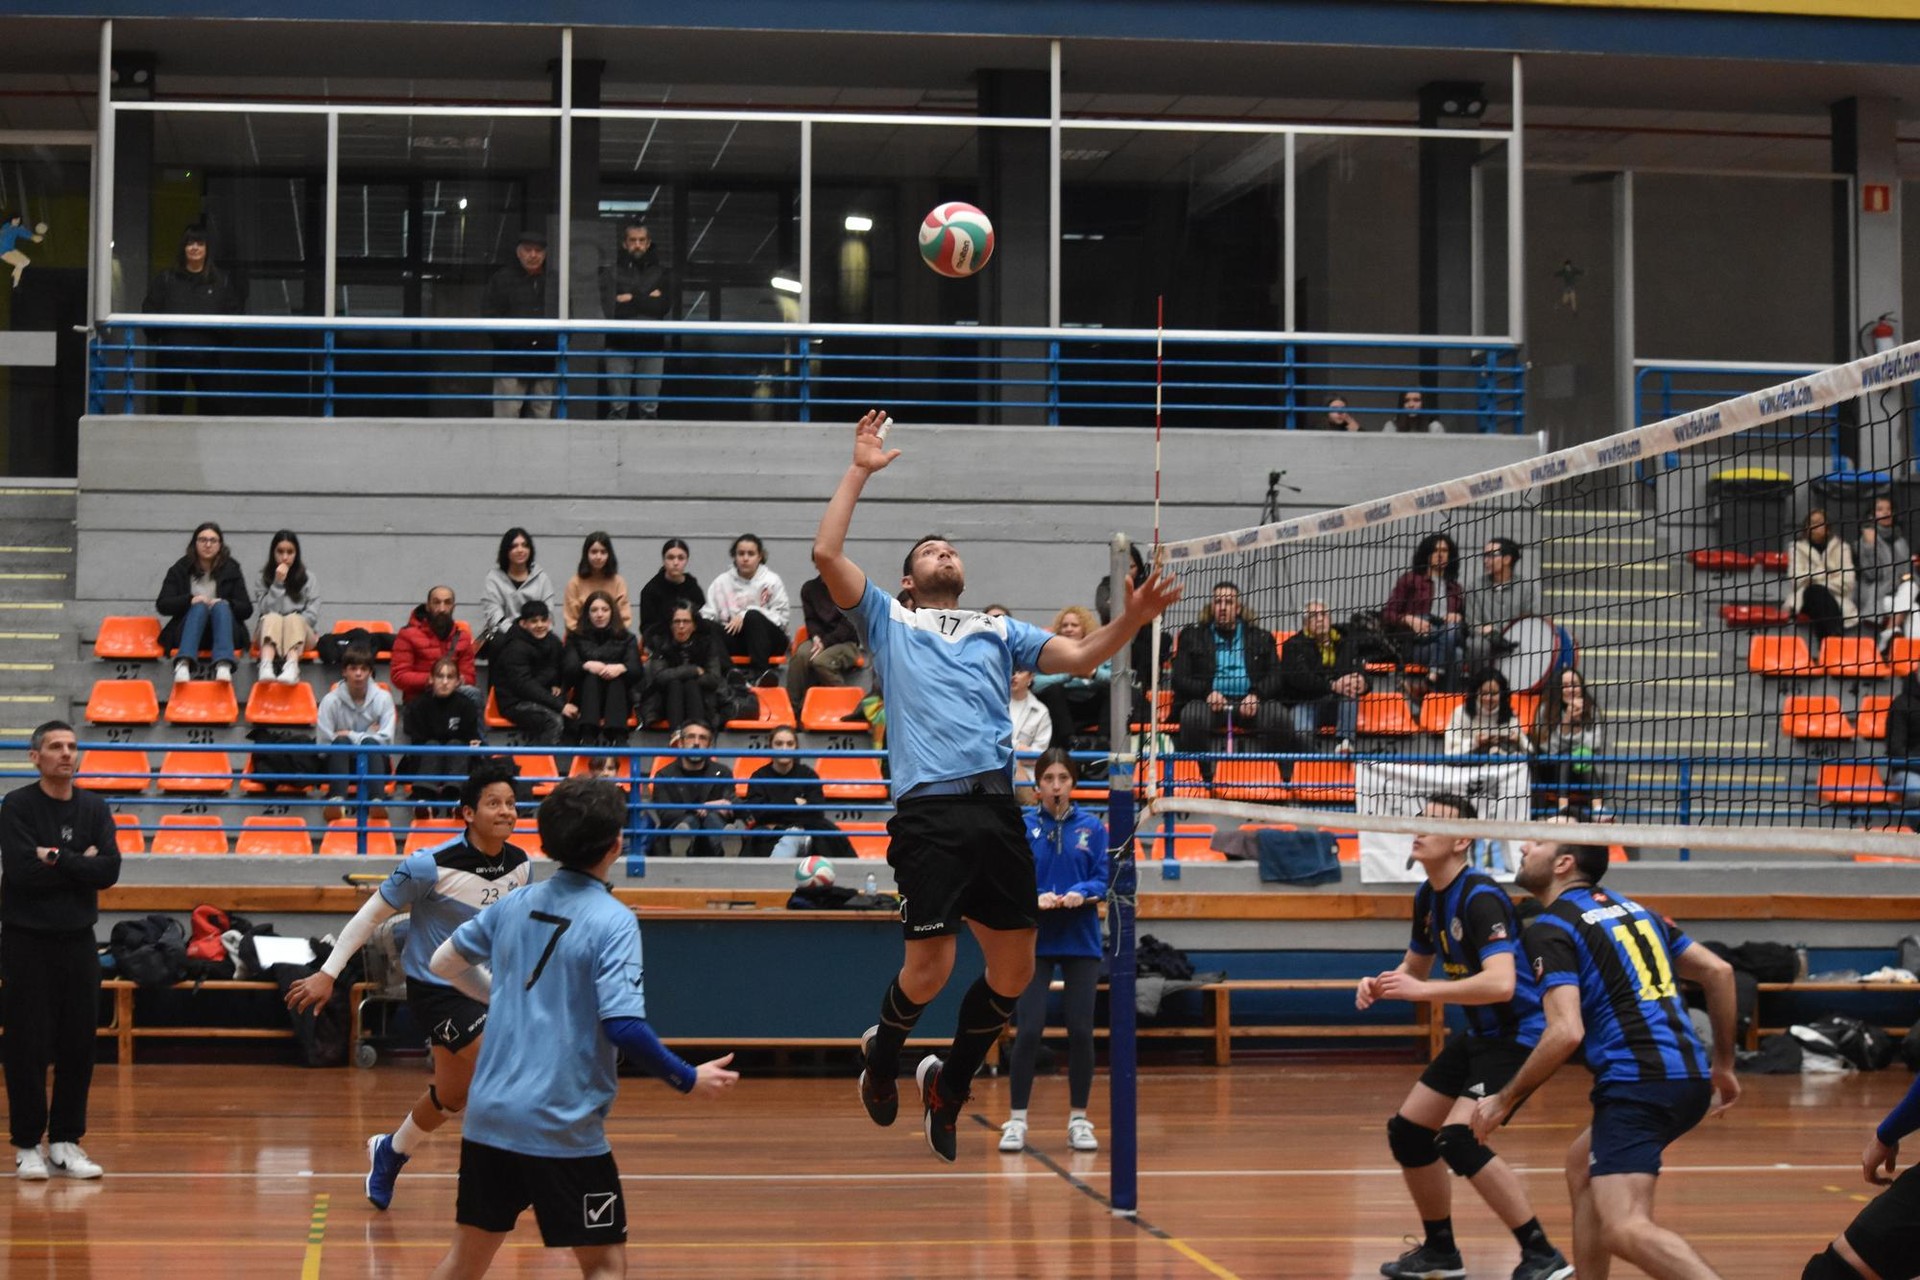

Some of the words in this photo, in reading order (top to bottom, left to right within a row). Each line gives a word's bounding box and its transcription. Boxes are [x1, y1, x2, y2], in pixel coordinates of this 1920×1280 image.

[938, 614, 961, 636] 17
[116, 664, 142, 680] 27
[107, 728, 133, 744] 27
[187, 729, 214, 744] 28
[827, 736, 855, 750] 36
[481, 887, 499, 905] 23
[526, 910, 572, 991] 7
[1611, 918, 1678, 1001] 11
